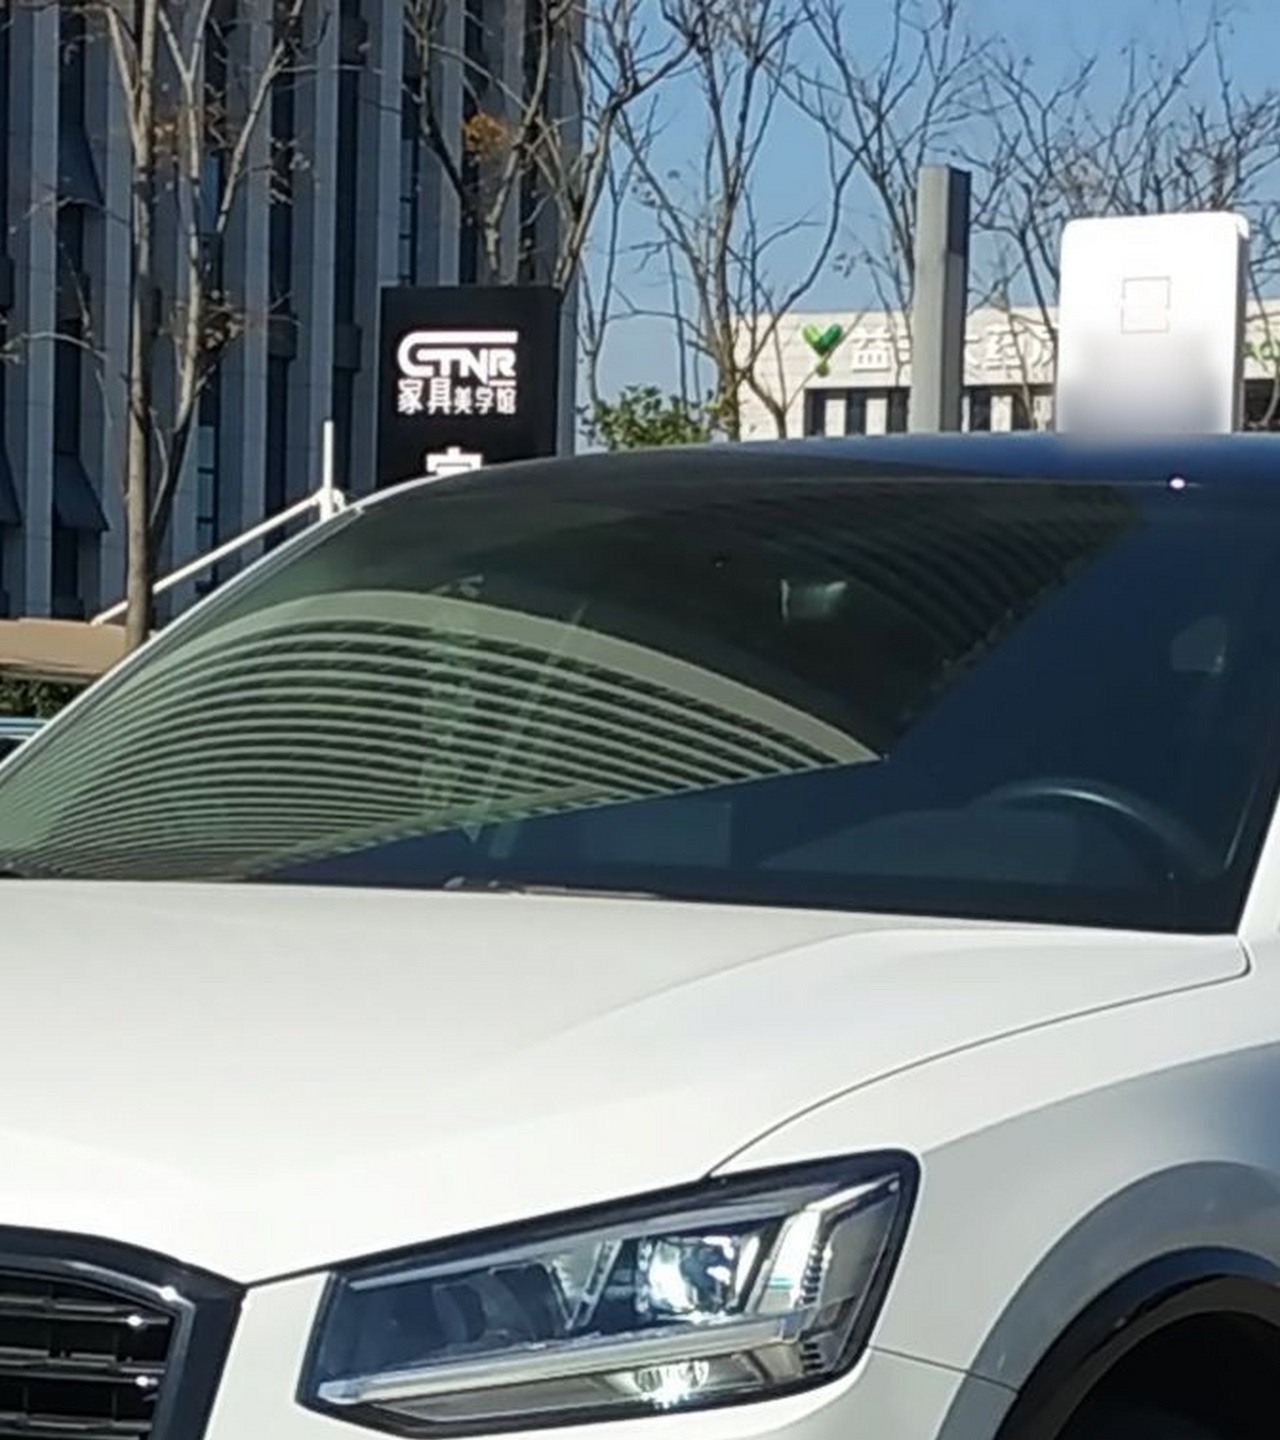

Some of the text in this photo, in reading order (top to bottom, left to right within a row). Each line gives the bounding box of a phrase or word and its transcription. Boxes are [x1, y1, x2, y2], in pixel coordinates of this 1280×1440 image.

[397, 378, 517, 415] 家具美学馆
